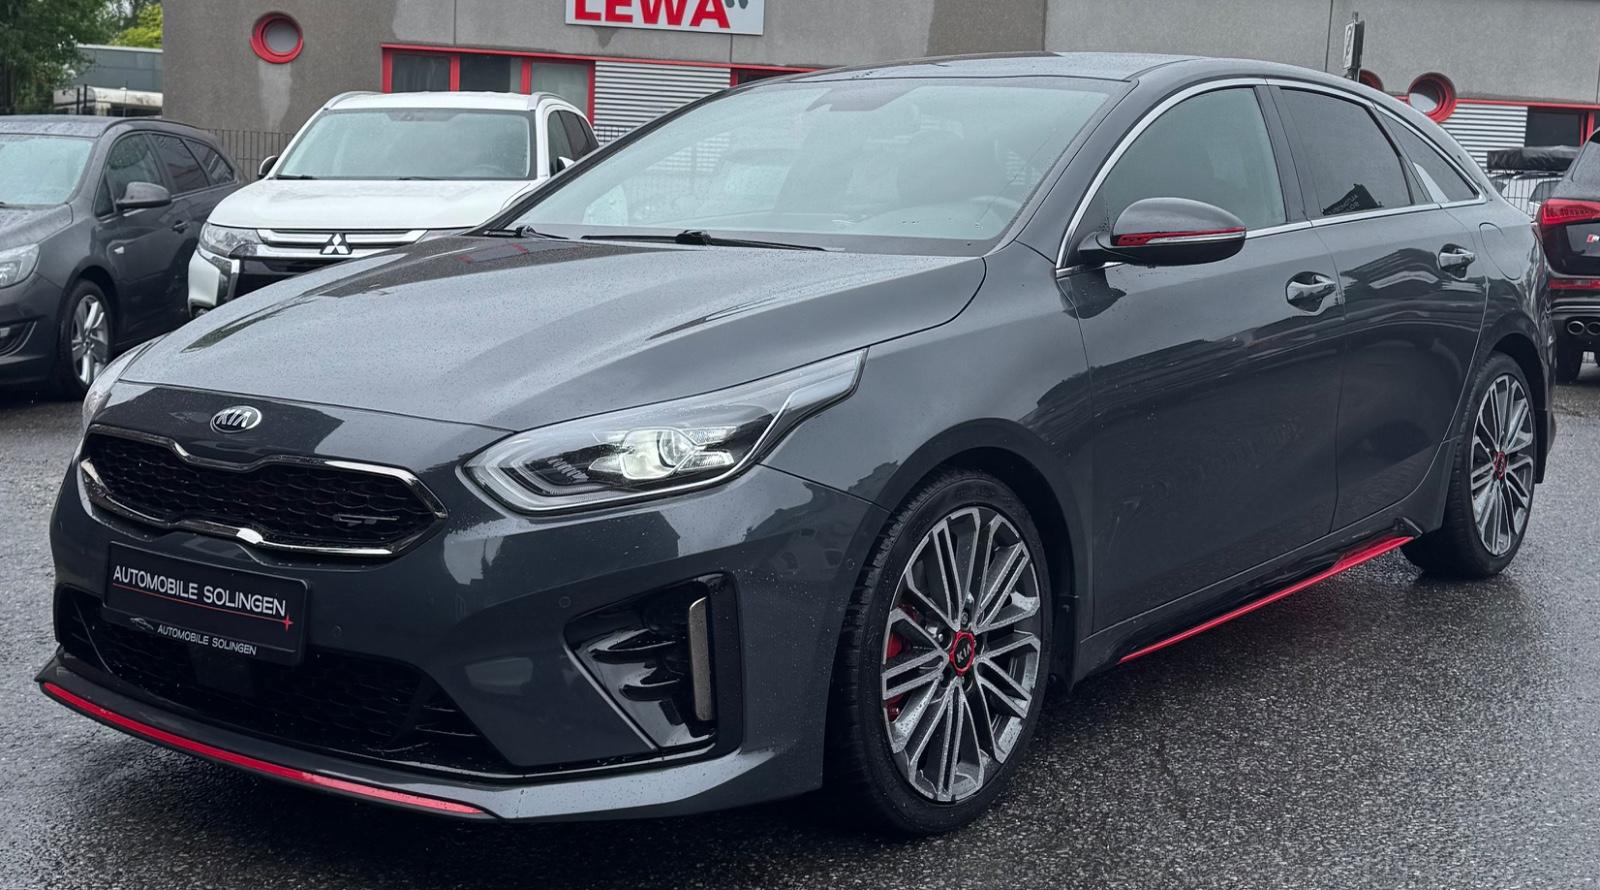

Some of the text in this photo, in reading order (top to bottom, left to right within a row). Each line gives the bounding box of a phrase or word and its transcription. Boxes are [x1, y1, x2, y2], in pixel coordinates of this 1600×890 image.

[574, 0, 731, 29] LEWA
[215, 408, 252, 428] KIA
[113, 565, 286, 617] AUTOMOBILE SOLINGEN
[157, 624, 257, 656] AUTOMOBILE SOLINGEN
[956, 642, 972, 664] KIA
